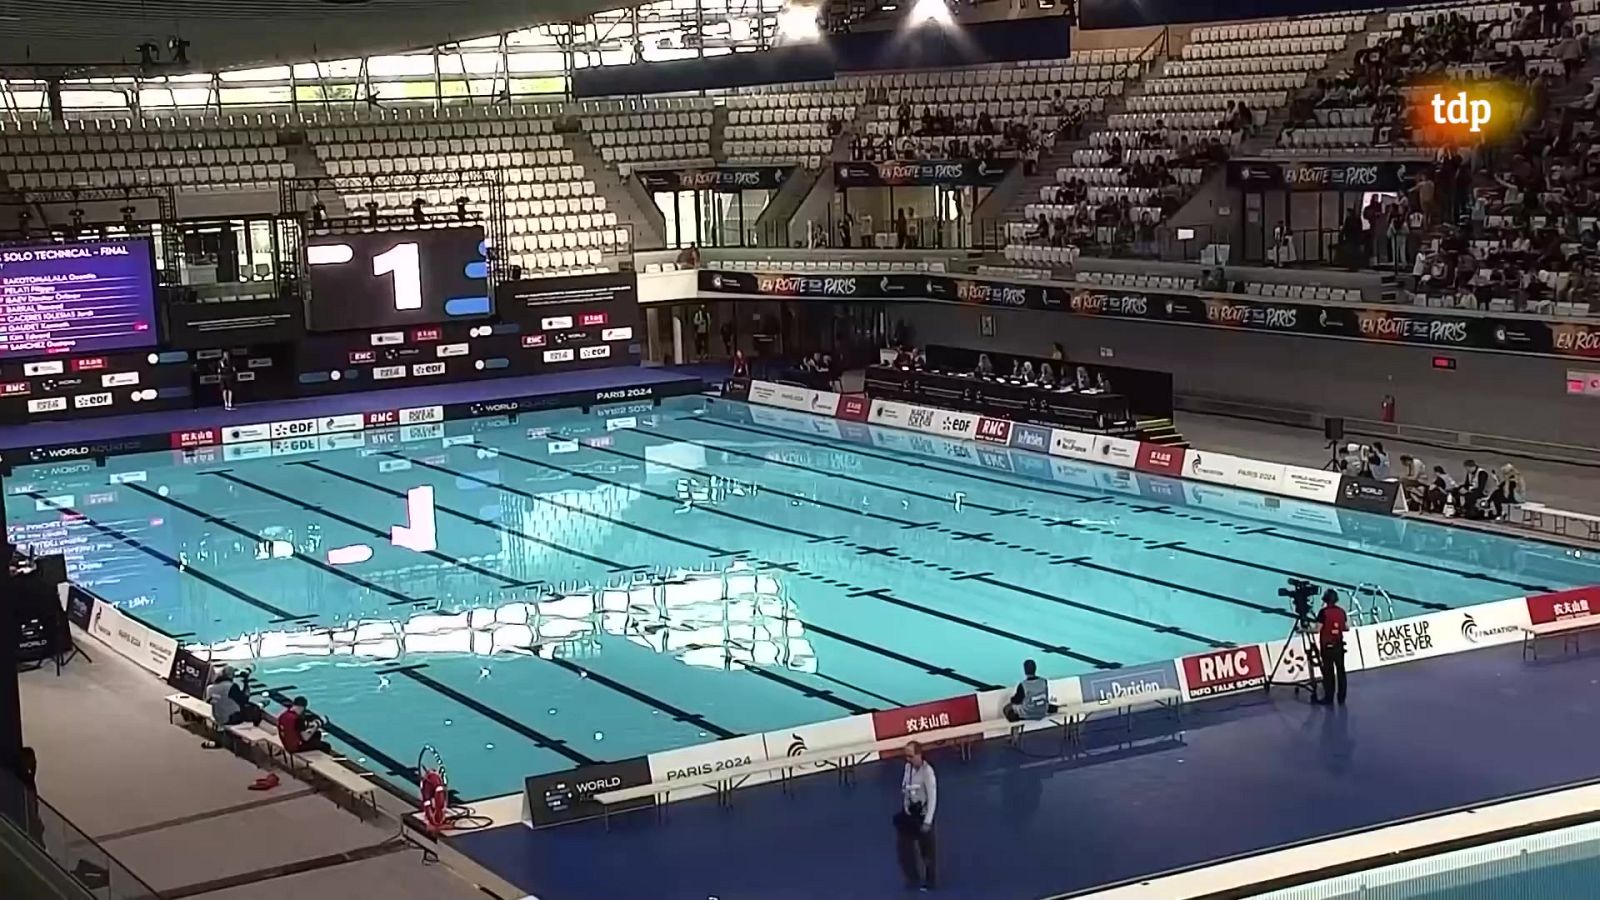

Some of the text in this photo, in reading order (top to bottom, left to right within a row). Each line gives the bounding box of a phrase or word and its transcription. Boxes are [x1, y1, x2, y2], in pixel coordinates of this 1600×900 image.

[735, 172, 760, 185] PARIS
[935, 164, 962, 178] PARIS
[1285, 169, 1298, 183] EN
[1298, 166, 1329, 184] ROUTE
[1346, 166, 1377, 184] PARIS
[3, 252, 33, 262] SOLO
[34, 248, 92, 261] TECHNICAL
[100, 246, 129, 256] FINAL
[373, 243, 422, 310] 1
[761, 278, 773, 291] EN
[774, 277, 807, 292] ROUTE
[824, 277, 856, 294] PARIS
[1002, 287, 1026, 304] PARIS
[1121, 296, 1147, 314] PARIS
[1209, 306, 1220, 320] EN
[1220, 305, 1251, 323] ROUTE
[1266, 308, 1297, 327] PARIS
[1361, 318, 1375, 333] EN
[1376, 316, 1412, 336] ROUTE
[1430, 320, 1467, 341] PARIS
[1556, 331, 1600, 350] EN ROU
[597, 388, 652, 400] PARIS 2024
[485, 402, 518, 412] WORLD
[371, 411, 393, 422] RMC
[982, 420, 1005, 436] RMC
[49, 447, 89, 457] WORLD
[1259, 472, 1276, 481] 2024
[1376, 621, 1430, 643] MAKE UP
[1378, 641, 1401, 657] FOR
[1404, 635, 1433, 652] EVER
[1198, 650, 1250, 683] RMC
[1190, 677, 1267, 698] INFO TALK SPORT
[667, 755, 752, 781] PARIS 2024
[577, 776, 621, 793] WORLD
